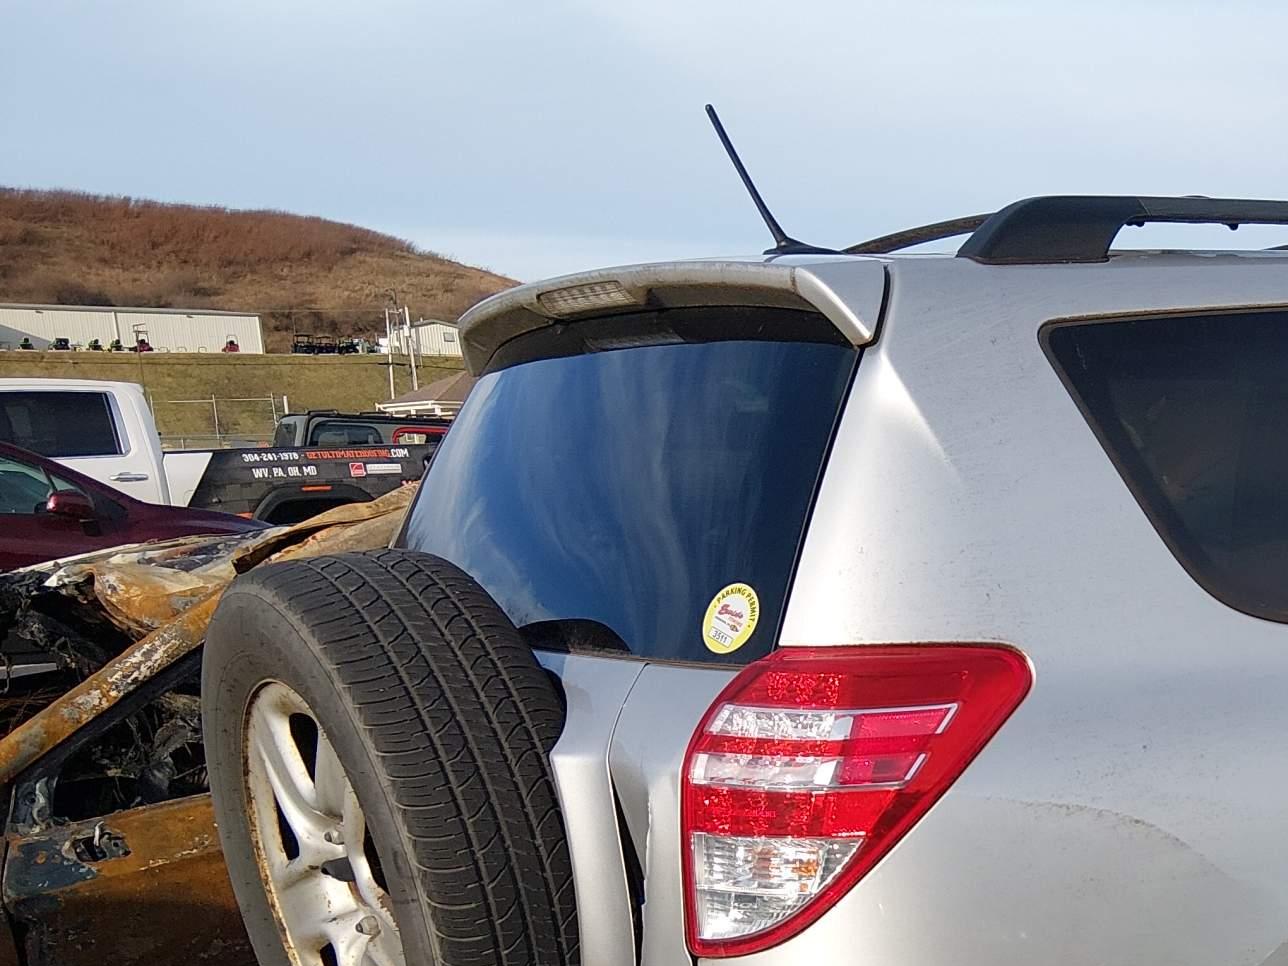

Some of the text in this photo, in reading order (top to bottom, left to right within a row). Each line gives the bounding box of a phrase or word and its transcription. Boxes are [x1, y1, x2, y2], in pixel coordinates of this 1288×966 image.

[252, 465, 317, 478] WV, PA, OH, MD
[716, 587, 747, 603] PARKING
[746, 593, 757, 622] PERMIT
